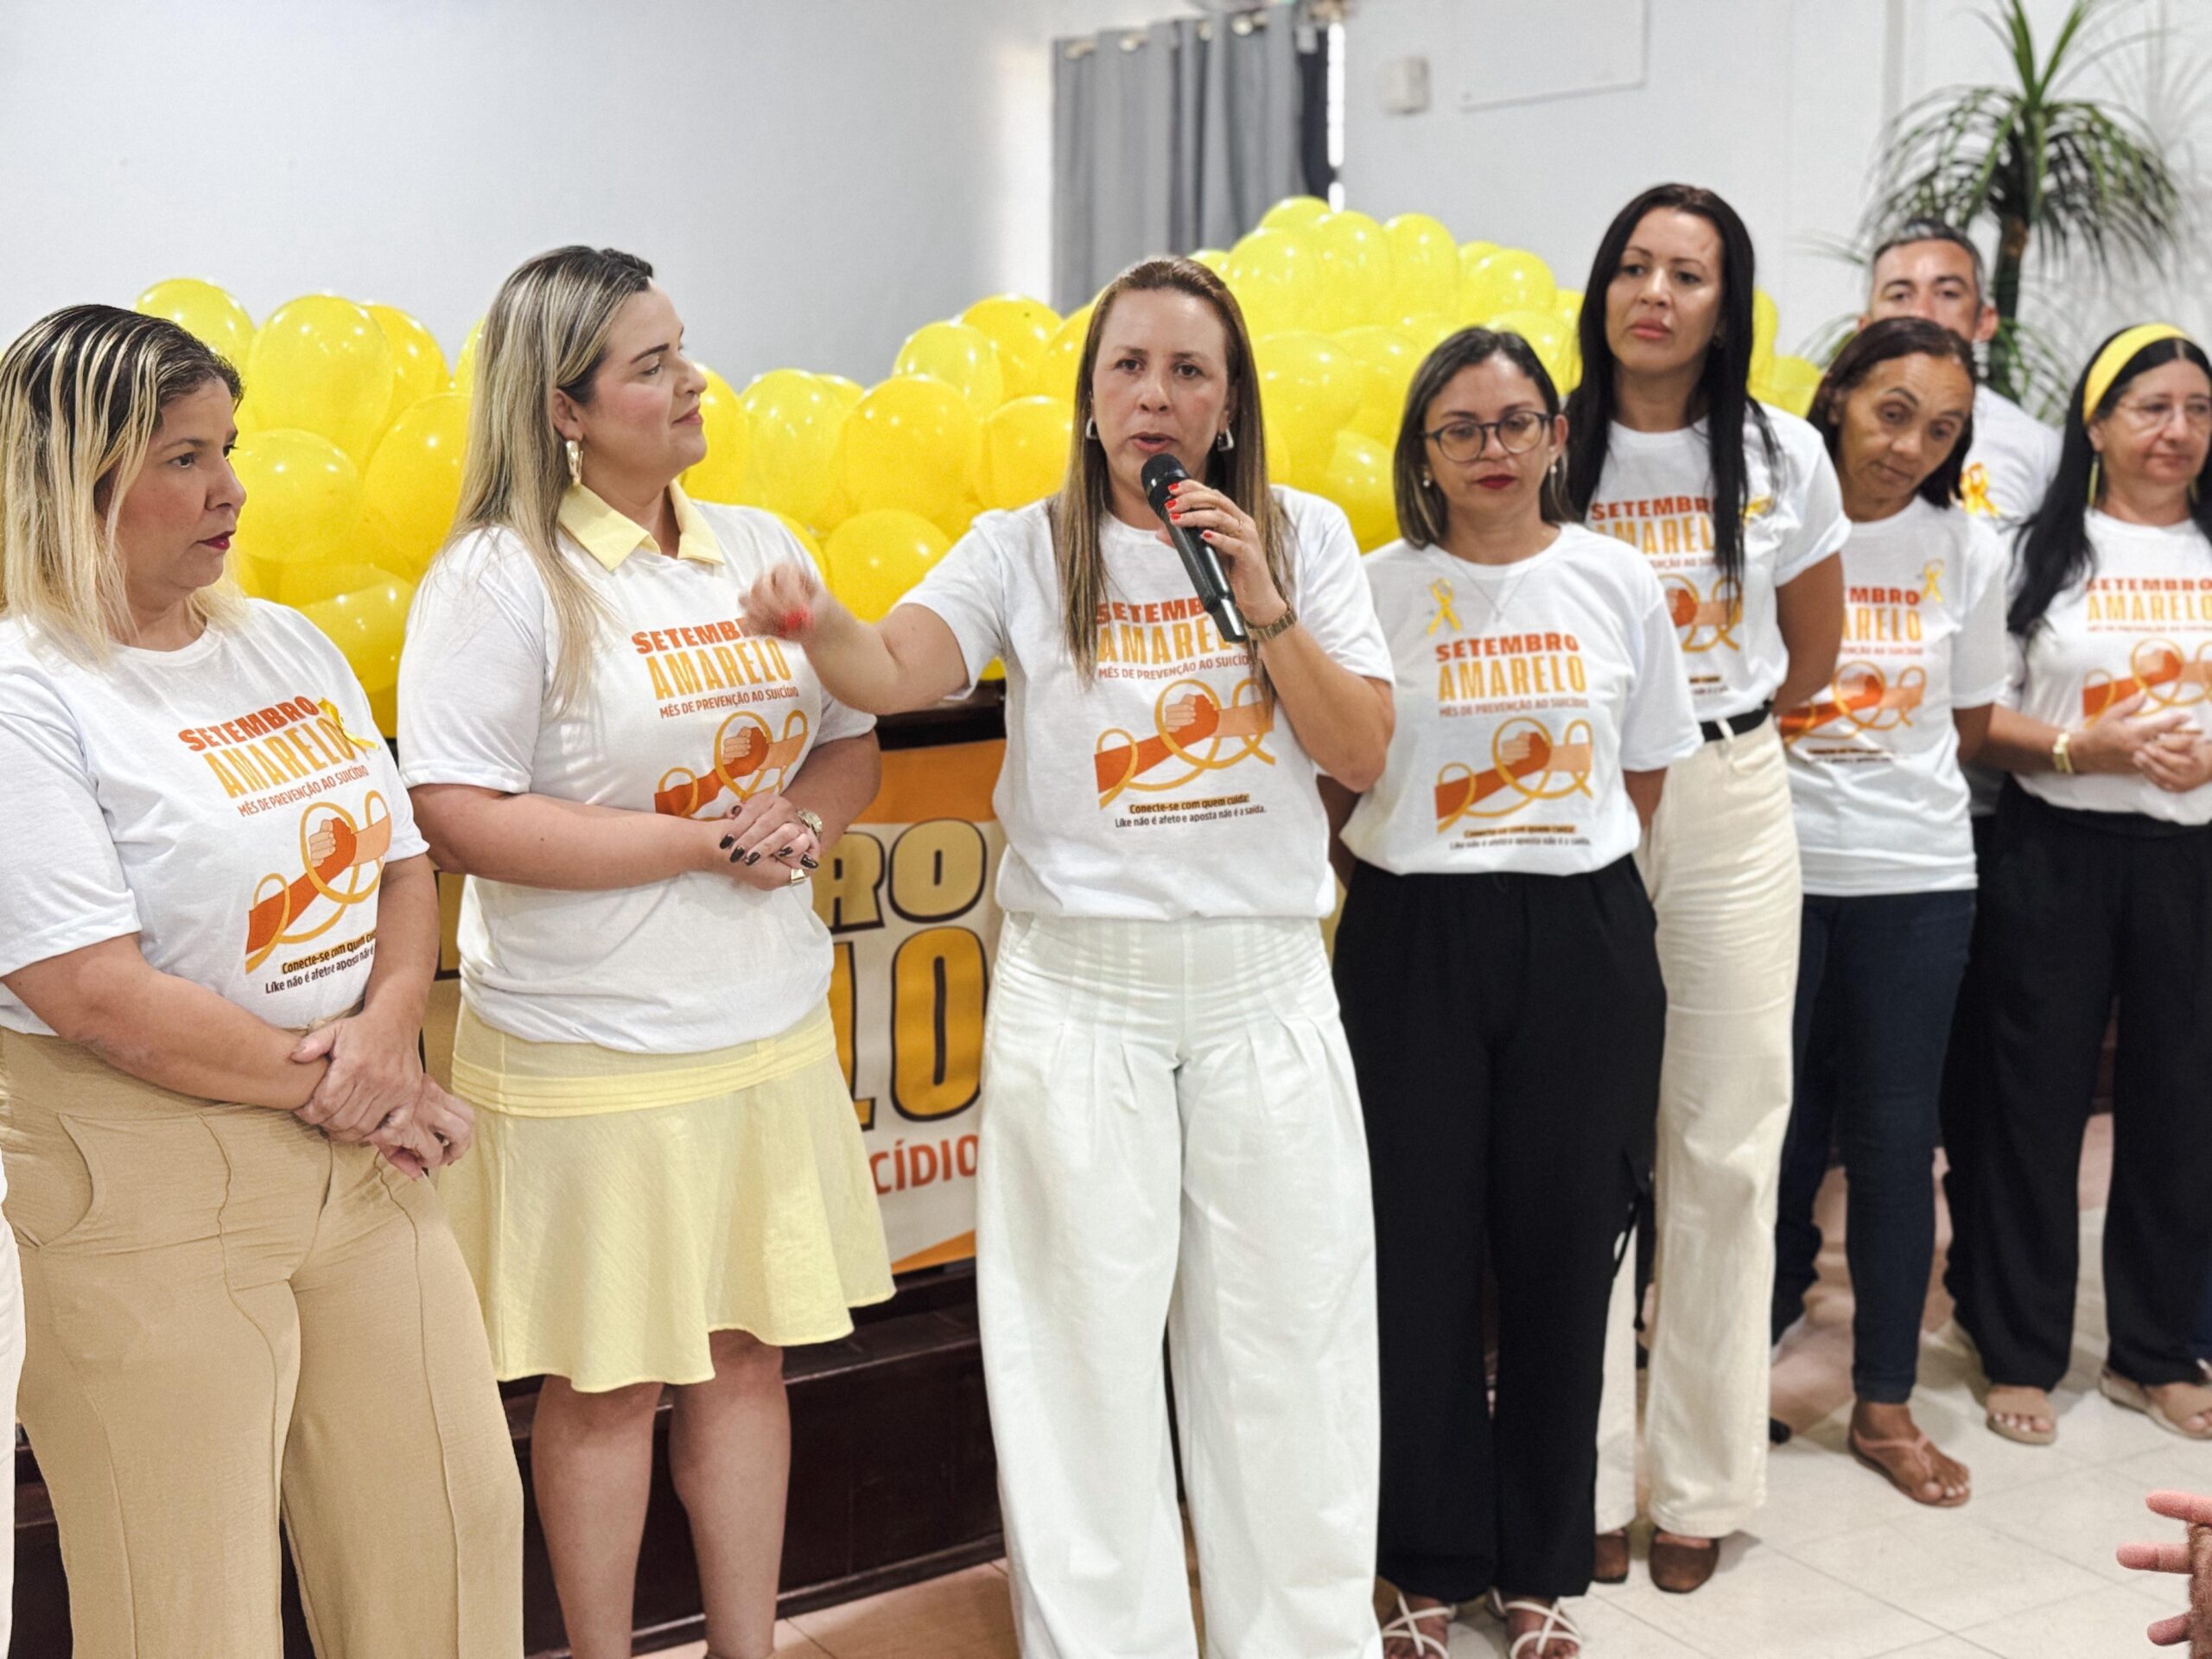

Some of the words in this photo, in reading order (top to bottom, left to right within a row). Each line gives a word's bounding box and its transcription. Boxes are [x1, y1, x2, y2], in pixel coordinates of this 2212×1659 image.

[1591, 496, 1716, 520] SETEMBR
[1434, 632, 1580, 662] SETEMBRO
[645, 638, 792, 700] AMARELO
[1098, 666, 1120, 678] MÊS
[1122, 668, 1135, 678] DE
[1136, 662, 1196, 680] PREVENÇÃO
[1198, 658, 1214, 670] AO
[1438, 654, 1587, 702] AMARELO
[659, 702, 680, 719] MÊS
[682, 698, 696, 714] DE
[696, 691, 750, 711] PREVENÇÃO
[752, 690, 765, 702] AO
[178, 696, 320, 751] SETEMBRO
[203, 716, 359, 798] AMARELO
[237, 800, 259, 817] MÊS
[258, 798, 272, 811] DE
[270, 781, 321, 807] PREVENÇÃO
[321, 775, 337, 791] AO
[334, 764, 370, 785] SUICÍDIO
[1129, 803, 1179, 814] Conecte-se
[1181, 800, 1200, 810] com
[1202, 797, 1226, 809] quem
[1115, 818, 1132, 828] Like
[1134, 815, 1149, 826] não
[1151, 815, 1157, 824] é
[1159, 813, 1181, 824] afeto
[1189, 811, 1217, 823] aposta
[1218, 809, 1232, 819] não
[282, 951, 330, 975] Conecte-se
[331, 944, 346, 958] com
[265, 981, 286, 995] Like
[287, 976, 303, 989] não
[304, 971, 310, 983] é
